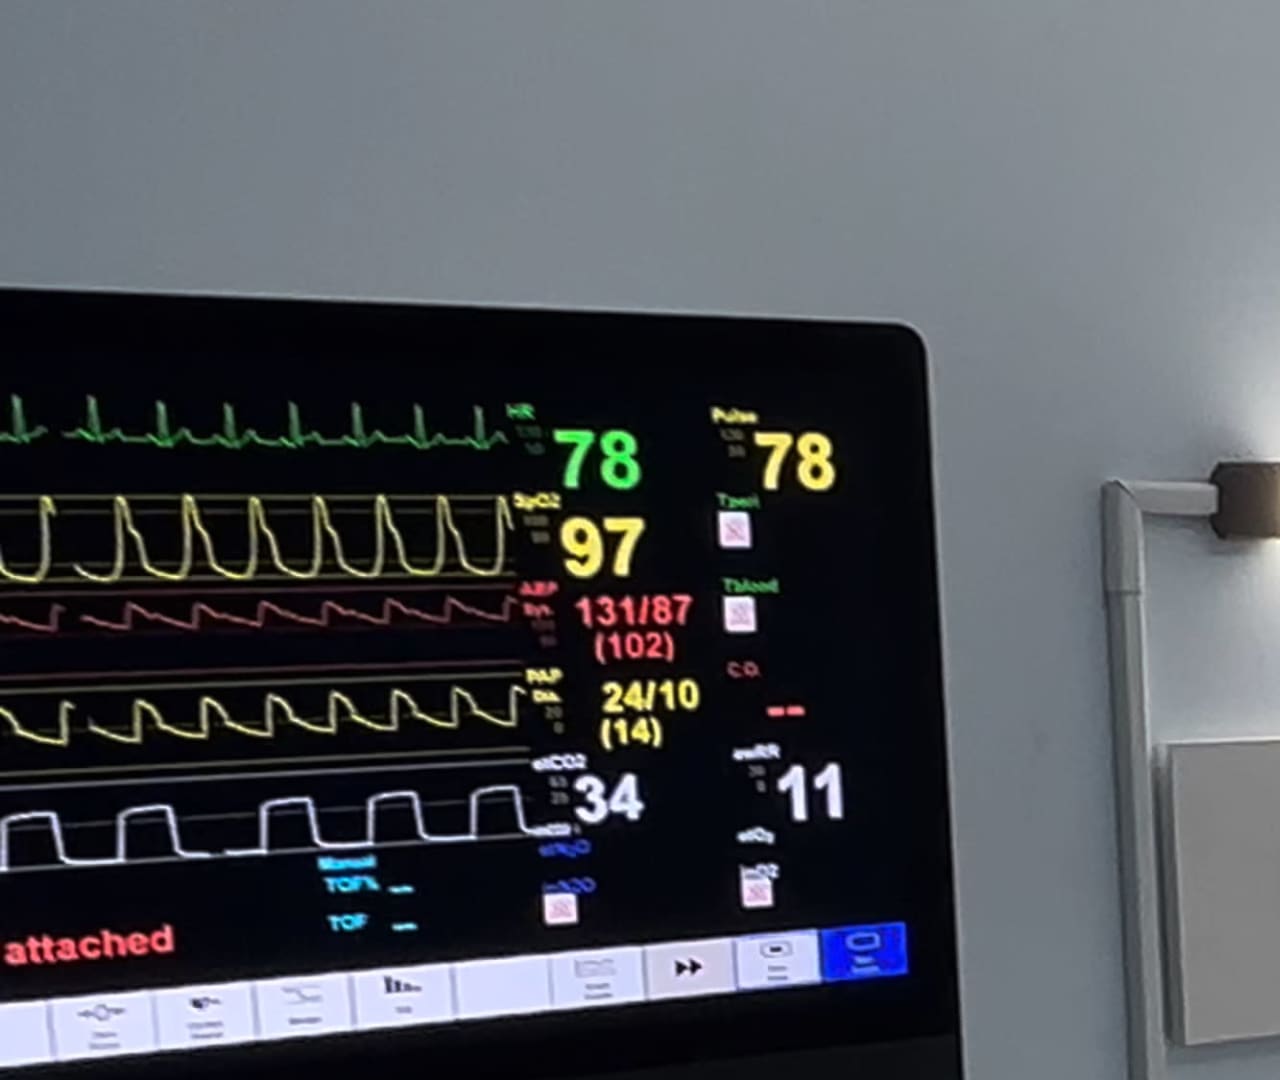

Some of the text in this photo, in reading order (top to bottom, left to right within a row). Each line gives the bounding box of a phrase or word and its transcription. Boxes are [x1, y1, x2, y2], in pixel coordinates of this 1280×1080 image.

[552, 429, 642, 489] 78
[753, 431, 836, 490] 78
[559, 516, 646, 577] 97
[575, 595, 694, 629] 131/87
[594, 632, 676, 662] (102)
[602, 679, 700, 714] 24/10
[600, 719, 664, 750] (14)
[573, 772, 646, 824] 34
[777, 763, 846, 822] 11
[3, 924, 176, 966] attached
